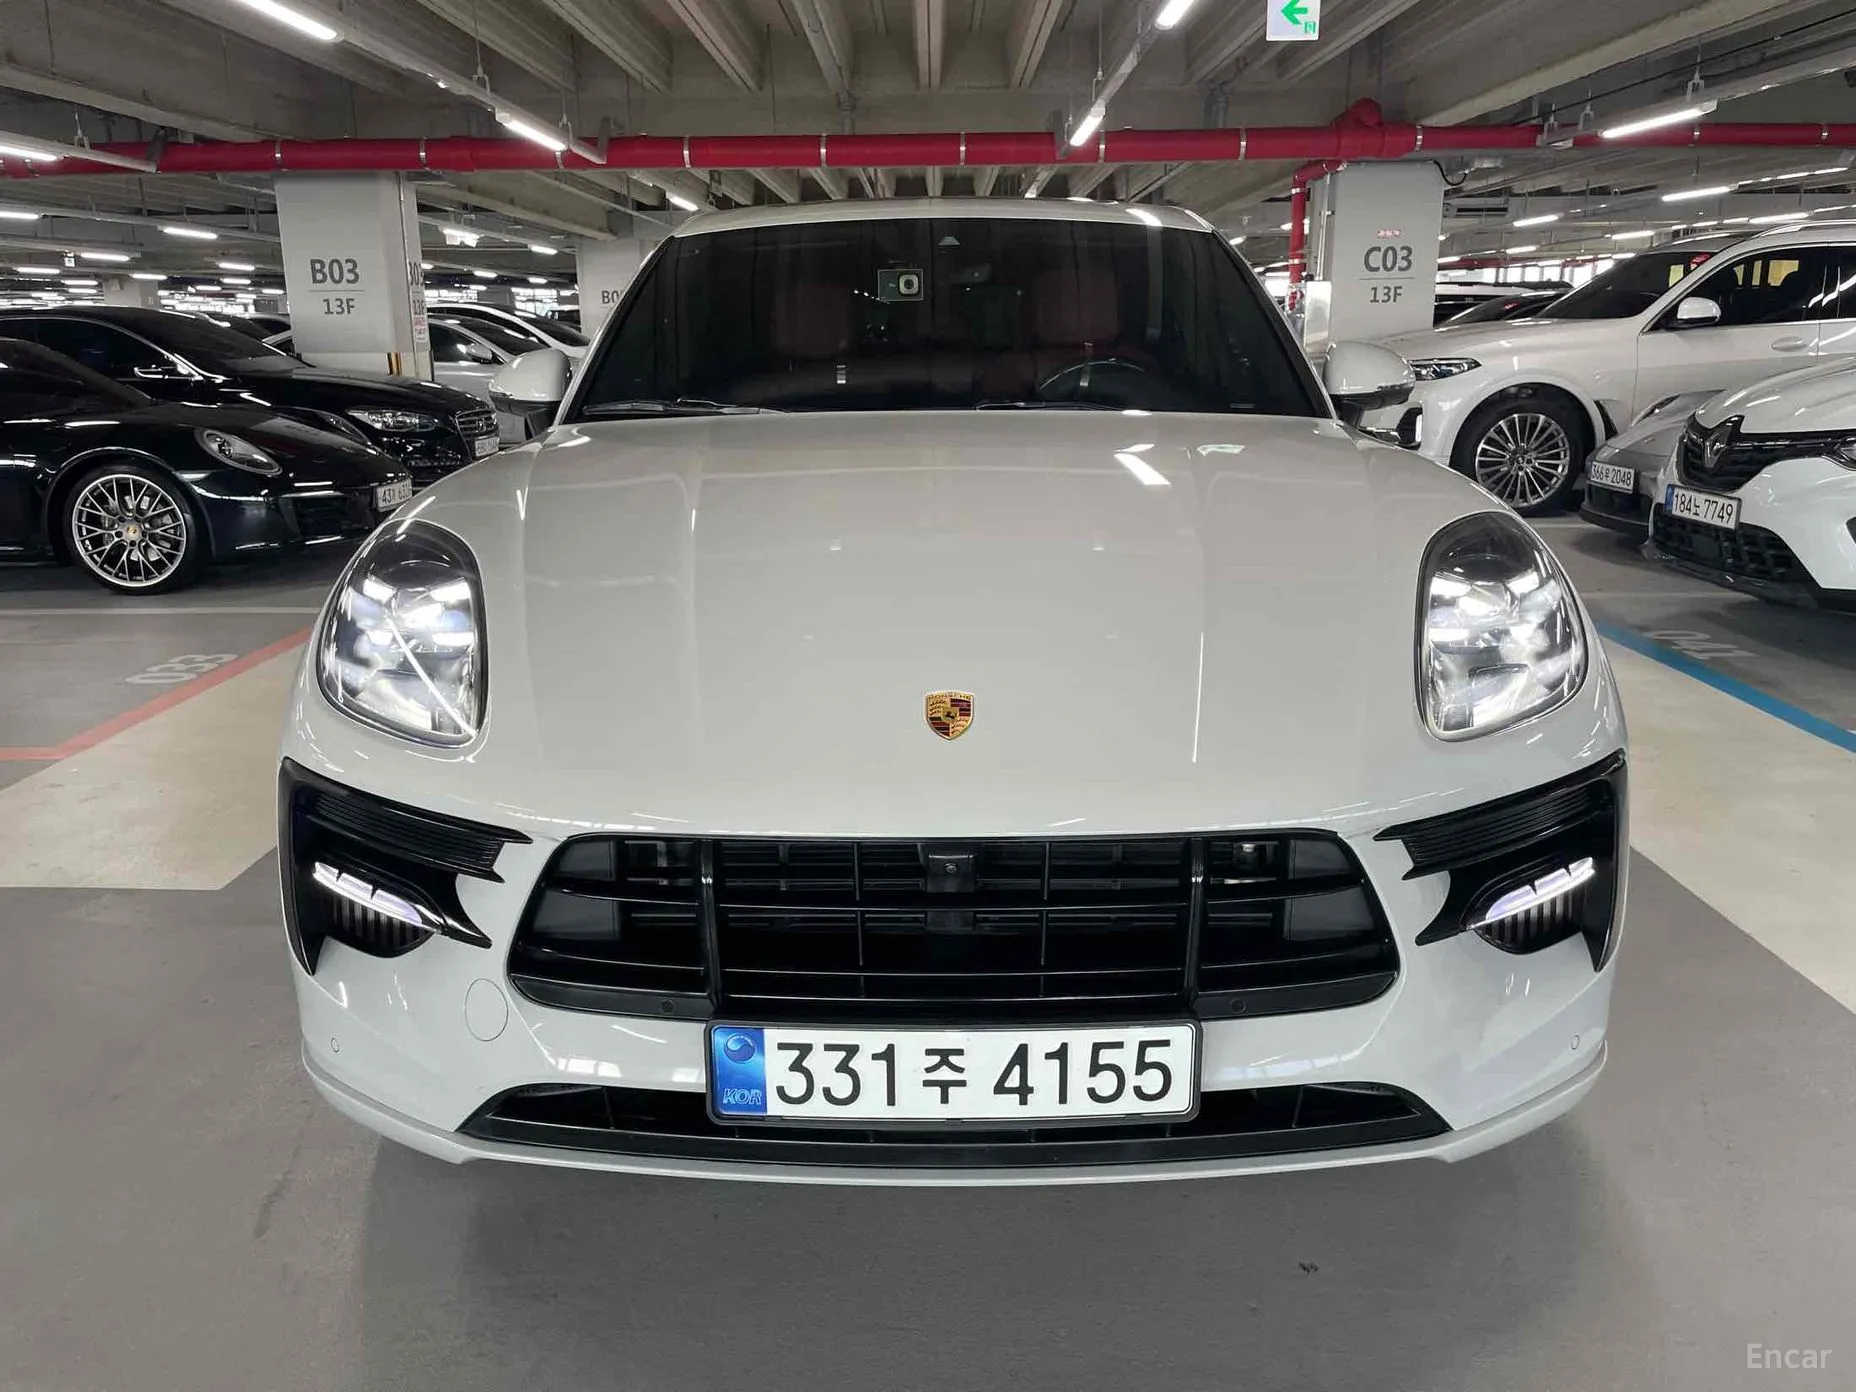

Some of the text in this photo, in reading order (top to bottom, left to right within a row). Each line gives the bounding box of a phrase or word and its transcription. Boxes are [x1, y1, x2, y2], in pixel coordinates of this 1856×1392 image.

[1364, 246, 1413, 272] C03
[310, 259, 360, 285] B03
[1370, 286, 1403, 303] 13F
[323, 298, 355, 315] 13F
[1611, 468, 1632, 487] 2048
[1674, 492, 1734, 525] 184노 7749
[775, 1039, 1171, 1107] 331주 4155
[722, 1088, 762, 1105] KOR
